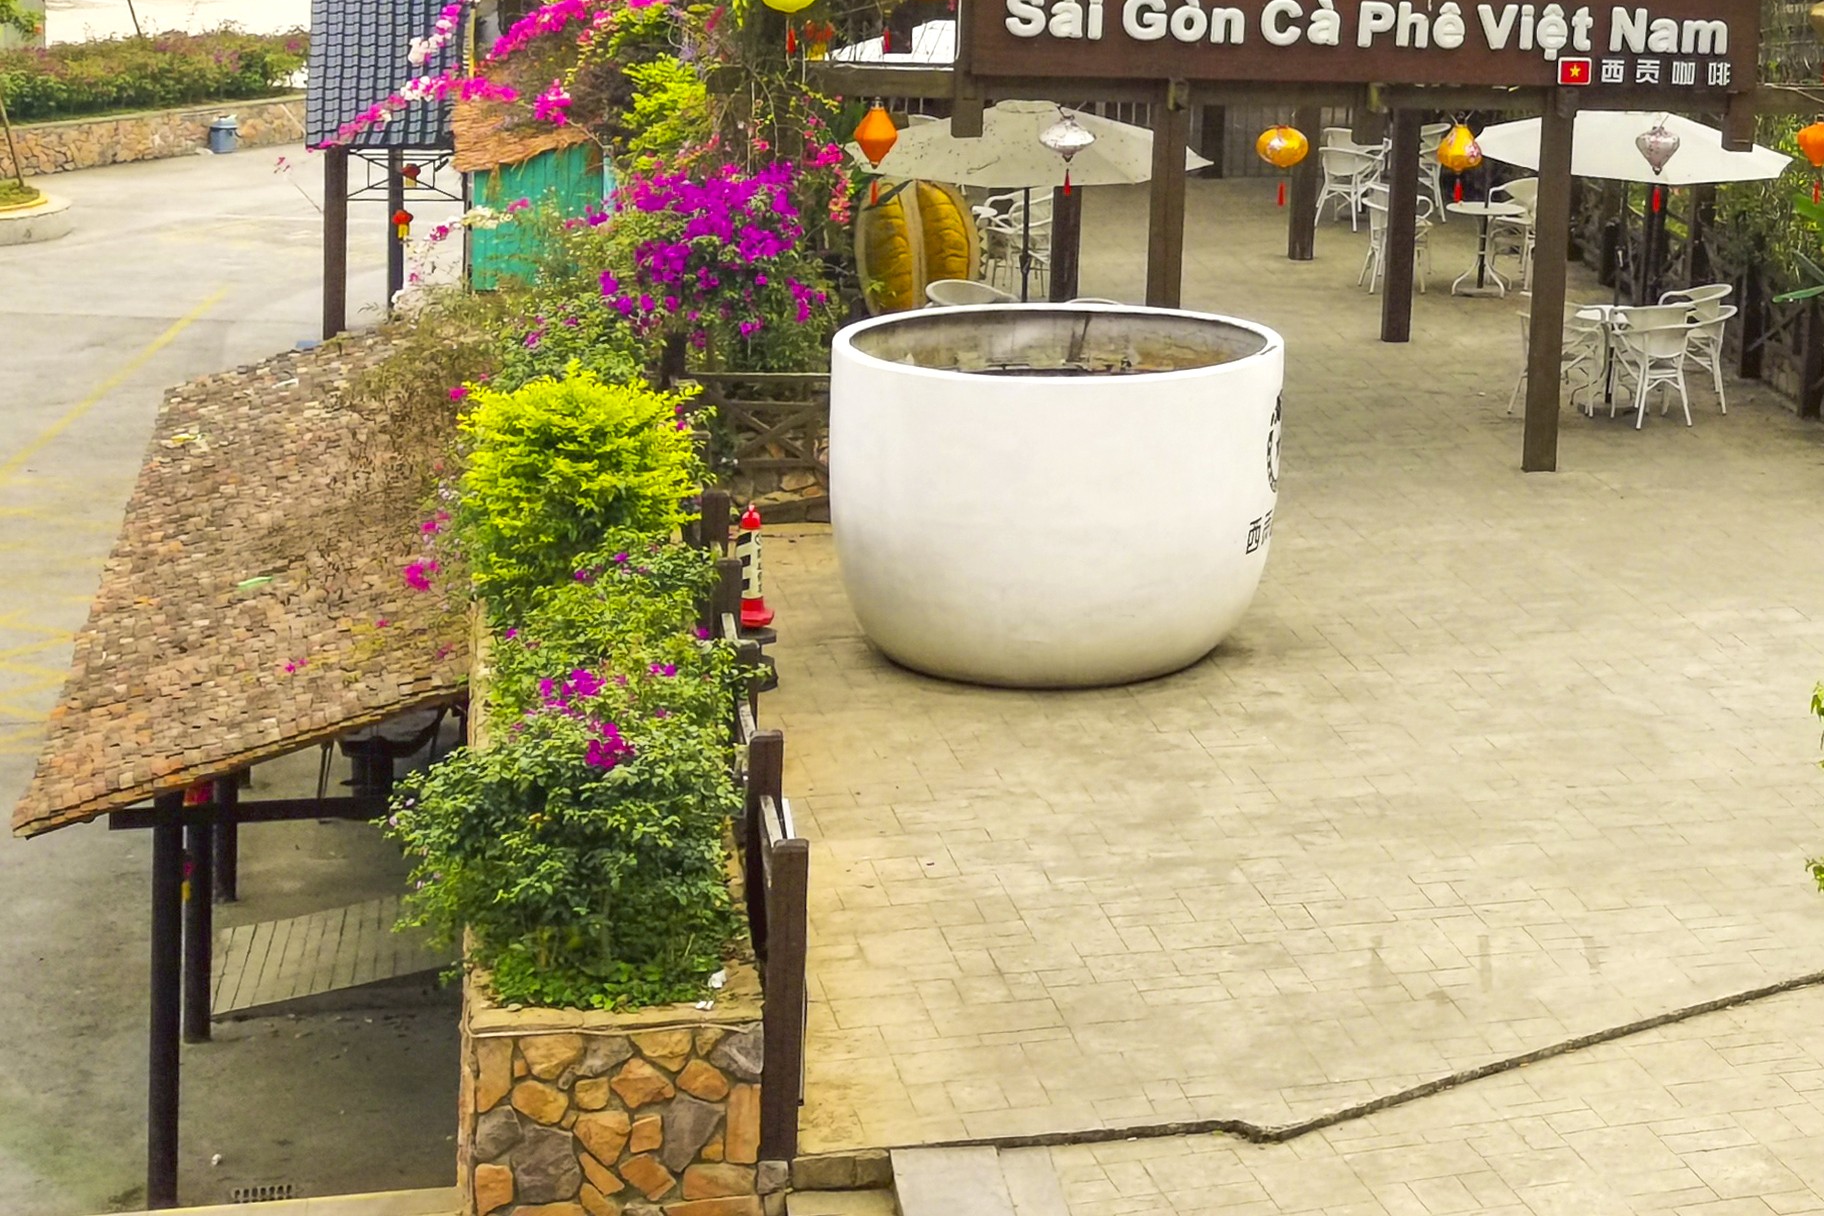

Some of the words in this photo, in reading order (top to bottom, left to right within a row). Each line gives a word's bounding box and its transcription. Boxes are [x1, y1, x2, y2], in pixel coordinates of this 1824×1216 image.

[1357, 0, 1466, 49] Phê
[1477, 2, 1594, 61] Việt
[1609, 6, 1728, 55] Nam
[1601, 59, 1731, 86] 西贡咖啡
